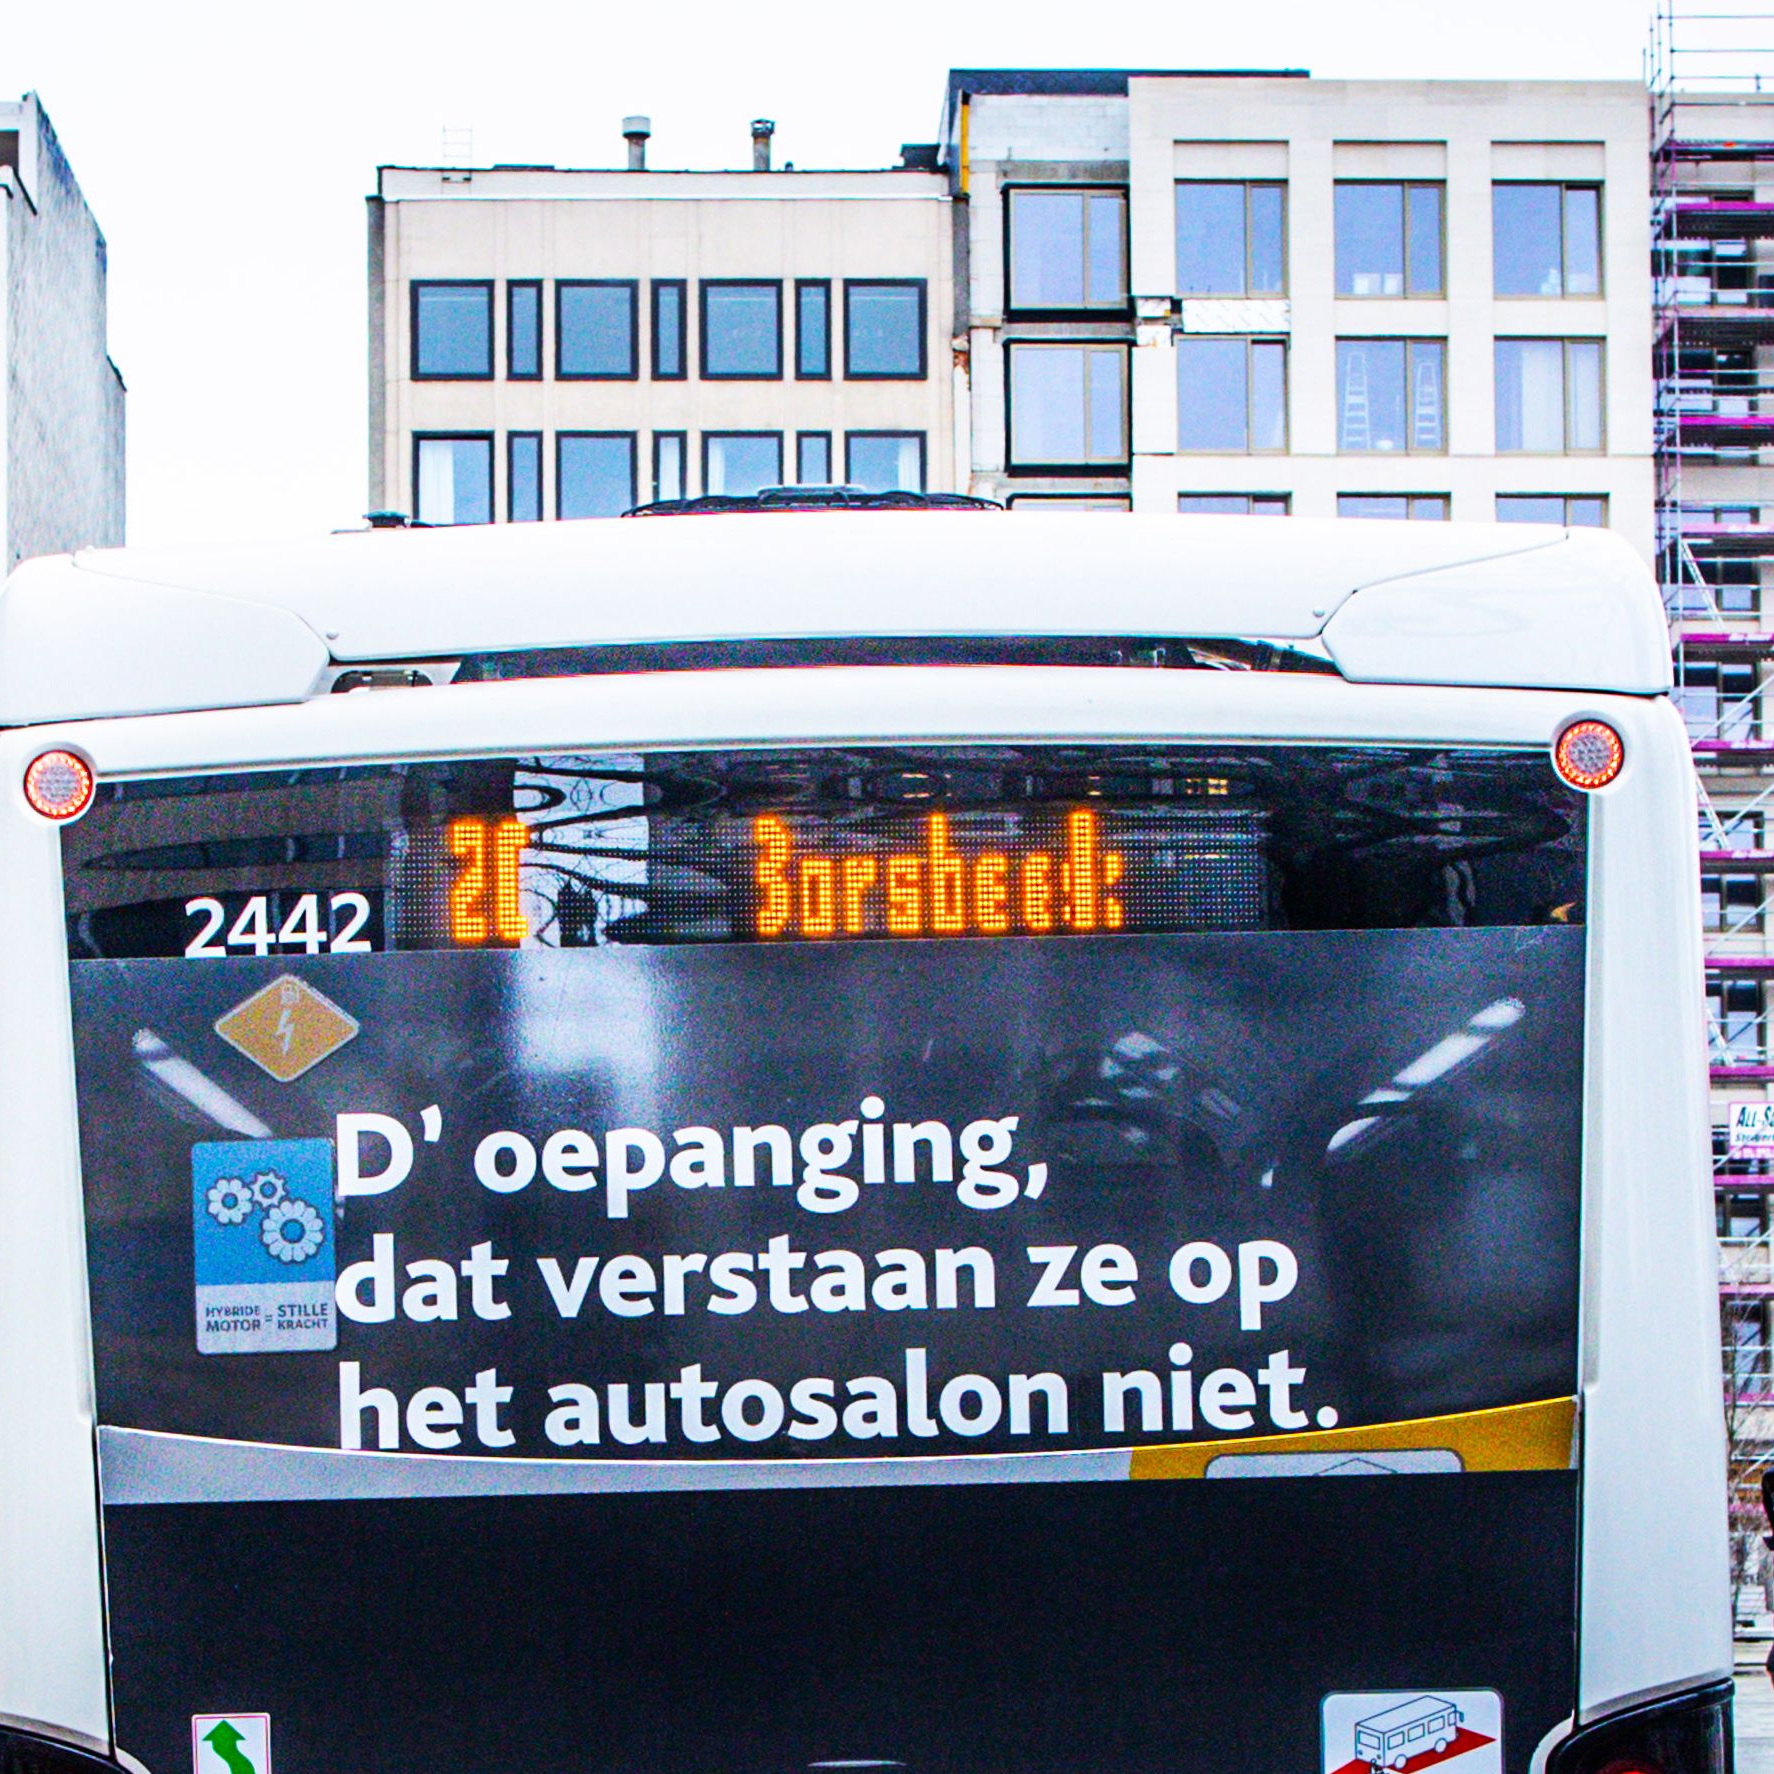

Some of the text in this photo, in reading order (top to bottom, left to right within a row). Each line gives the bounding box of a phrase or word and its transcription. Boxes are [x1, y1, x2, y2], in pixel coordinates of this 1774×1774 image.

[184, 892, 372, 958] 2442
[336, 1096, 1049, 1219] D' oepanging,
[334, 1233, 1299, 1331] dat verstaan ze op
[205, 1304, 261, 1318] HYBRIDE
[205, 1319, 261, 1333] MOTOR
[277, 1303, 329, 1317] STILLE
[277, 1318, 329, 1330] KRACHT
[339, 1342, 1339, 1450] het autosalon niet.
